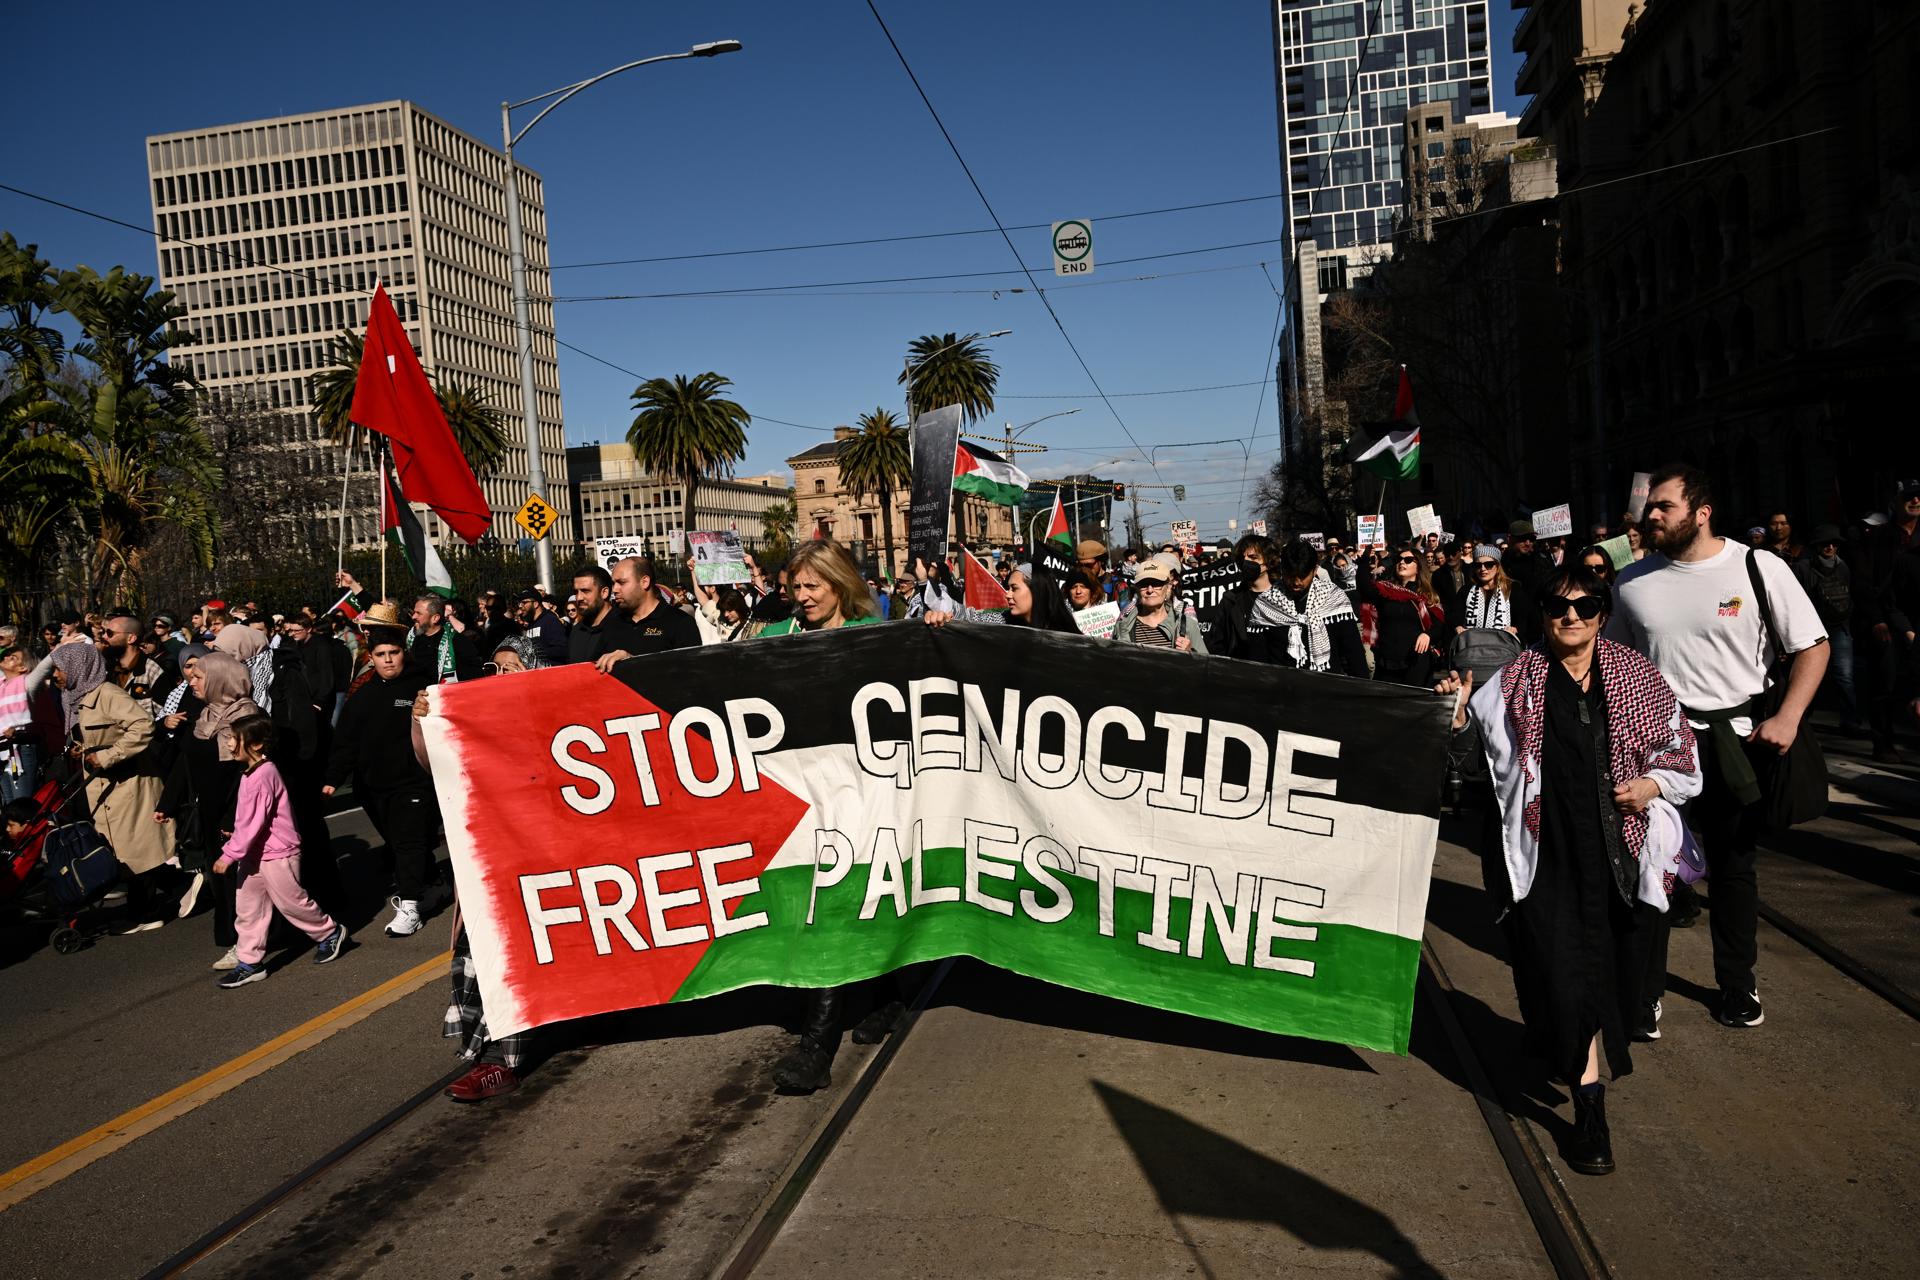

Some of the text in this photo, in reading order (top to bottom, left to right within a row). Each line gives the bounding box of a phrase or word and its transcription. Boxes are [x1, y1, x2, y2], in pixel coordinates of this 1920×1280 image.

[1062, 263, 1087, 273] END
[1172, 520, 1191, 530] FREE
[601, 547, 638, 556] GAZA
[1202, 562, 1242, 581] FASCI
[1717, 608, 1739, 617] FUTURE
[550, 676, 1341, 837] STOP GENOCIDE
[519, 817, 1326, 978] FREE PALESTINE
